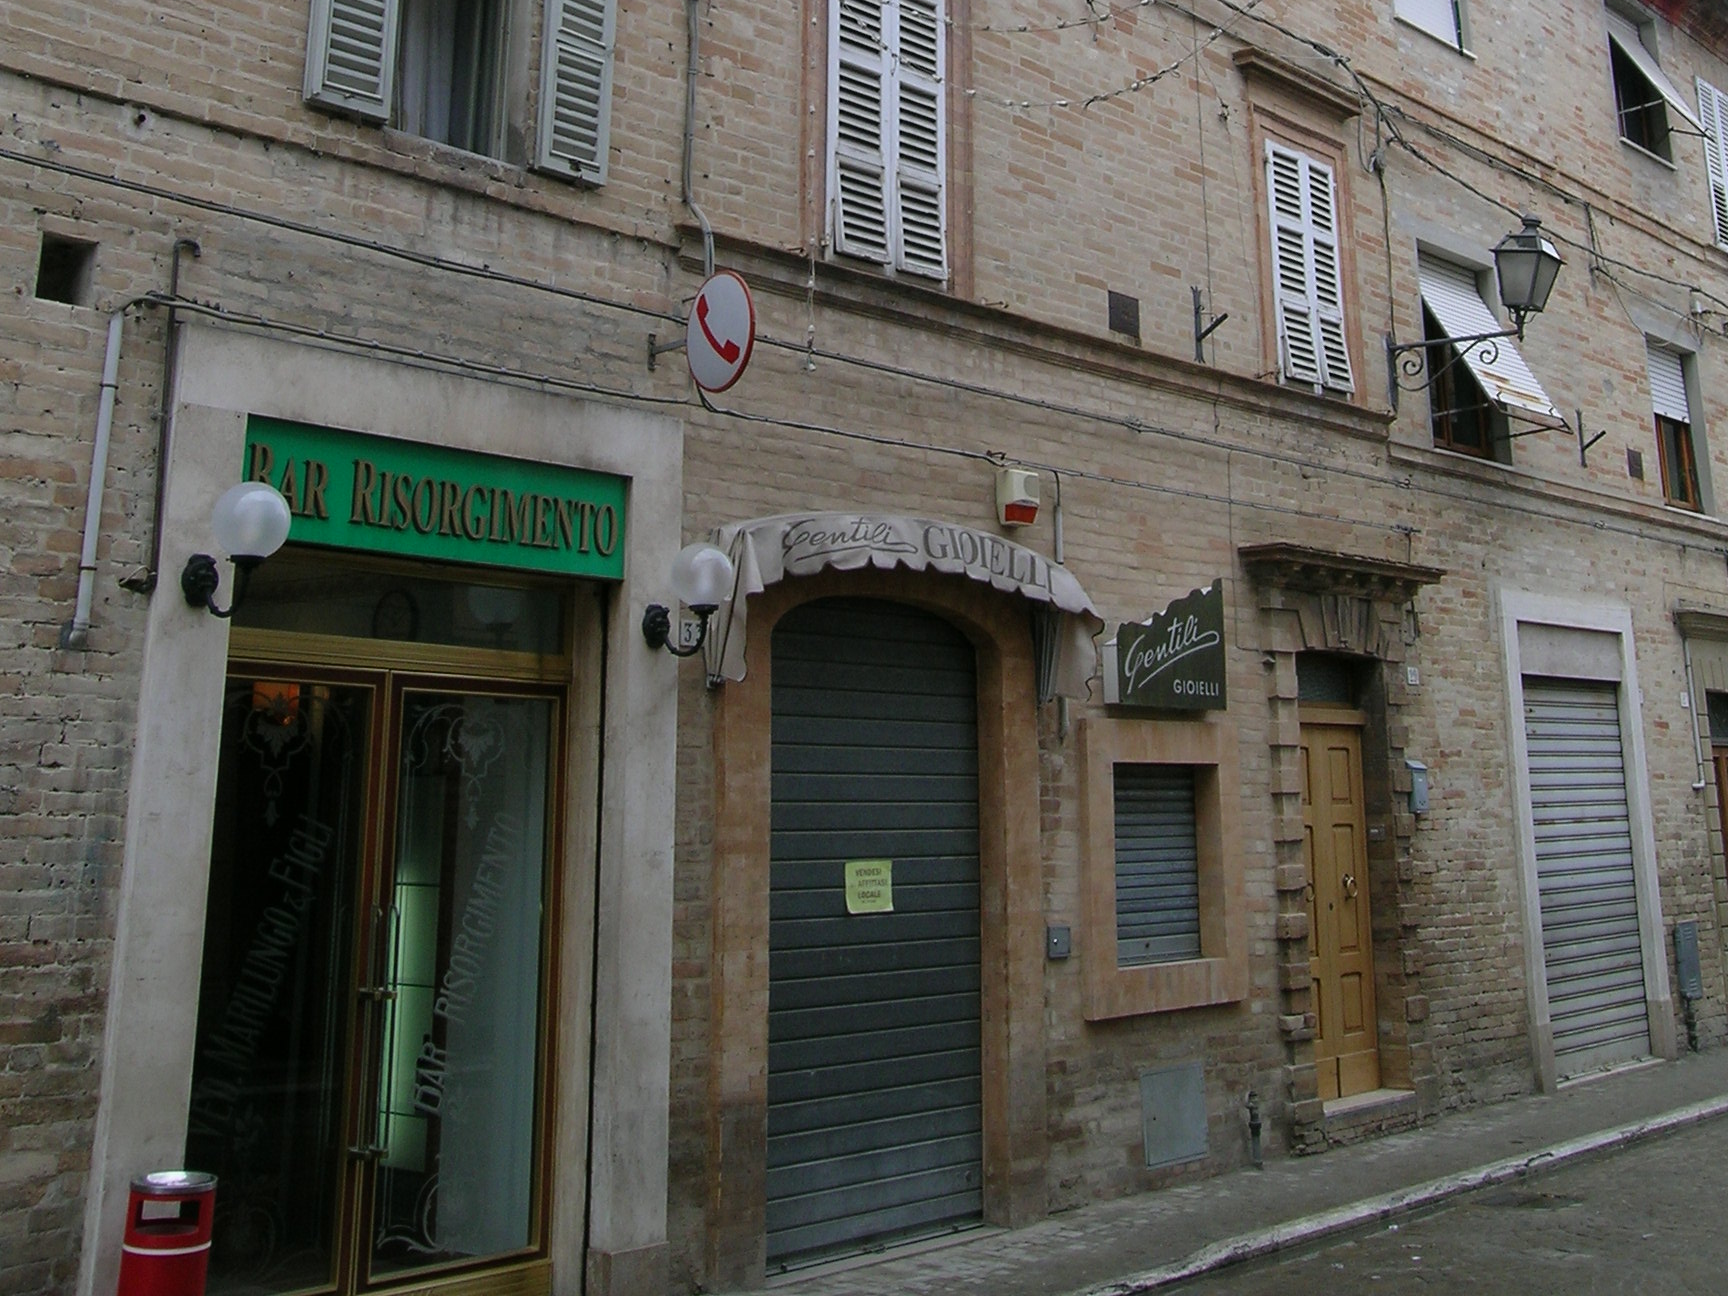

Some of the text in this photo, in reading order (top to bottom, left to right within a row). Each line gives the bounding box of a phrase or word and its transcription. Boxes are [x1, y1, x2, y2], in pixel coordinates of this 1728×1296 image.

[249, 443, 618, 556] BAR RISORGIMENTO
[782, 517, 1057, 596] Gentili GIOIELLI
[1124, 615, 1220, 695] Gentili
[1173, 679, 1219, 696] GIOIELLI
[269, 814, 333, 890] FIGLI
[435, 812, 525, 1021] RISORGIMENTO
